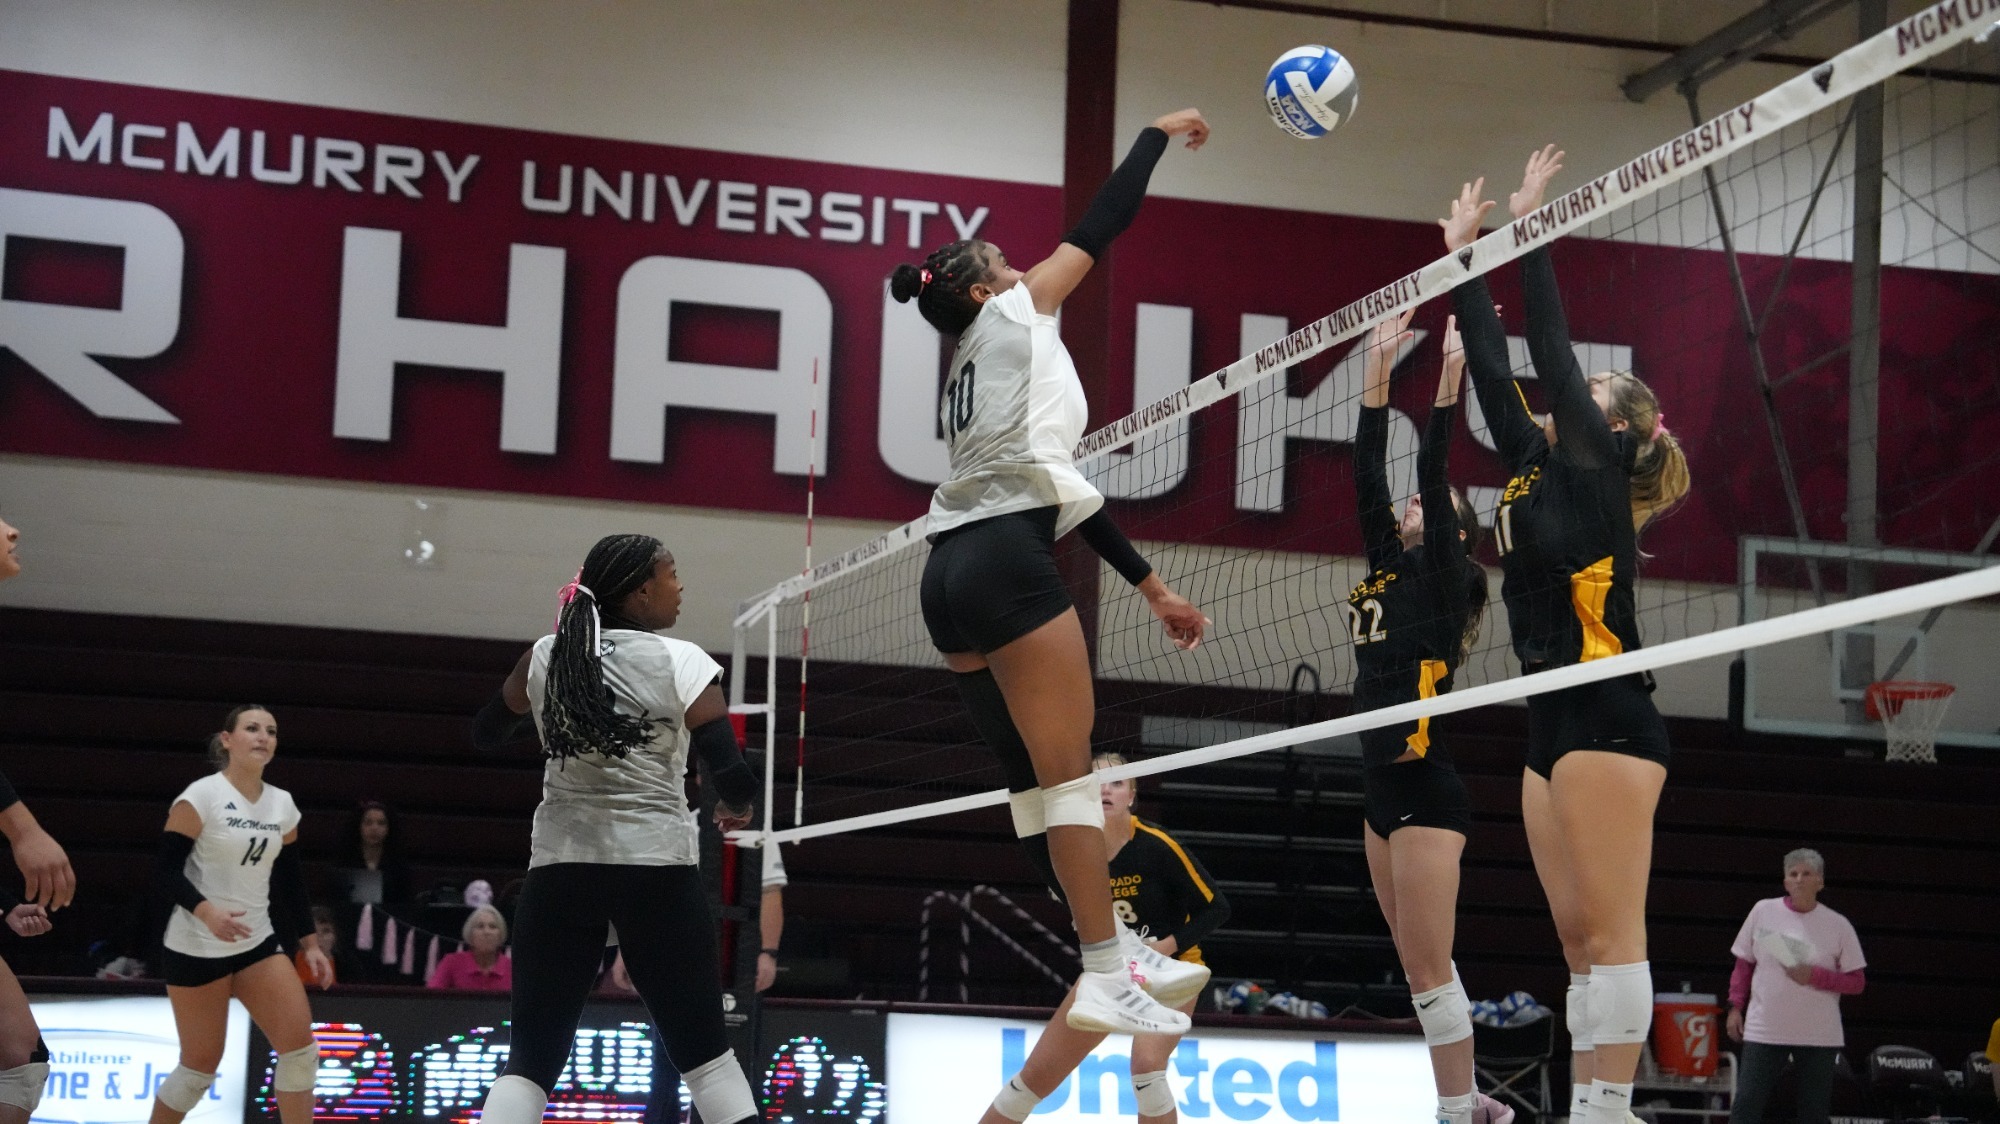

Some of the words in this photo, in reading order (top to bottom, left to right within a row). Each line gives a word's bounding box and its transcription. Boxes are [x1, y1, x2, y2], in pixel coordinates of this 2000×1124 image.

[1270, 97, 1306, 137] molten
[1280, 94, 1315, 131] NCAA
[1512, 175, 1609, 249] MCMURRY
[1616, 101, 1757, 194] UNIVERSITY
[521, 159, 990, 249] UNIVERSITY
[1255, 319, 1324, 375] MCMURRY
[1327, 270, 1422, 337] UNIVERSITY
[947, 360, 976, 447] 10
[1122, 386, 1191, 436] UNIVERSITY
[1347, 598, 1388, 645] 22
[240, 836, 269, 867] 14
[1109, 874, 1142, 888] RADO
[1112, 899, 1139, 923] 8
[104, 1071, 122, 1100] &
